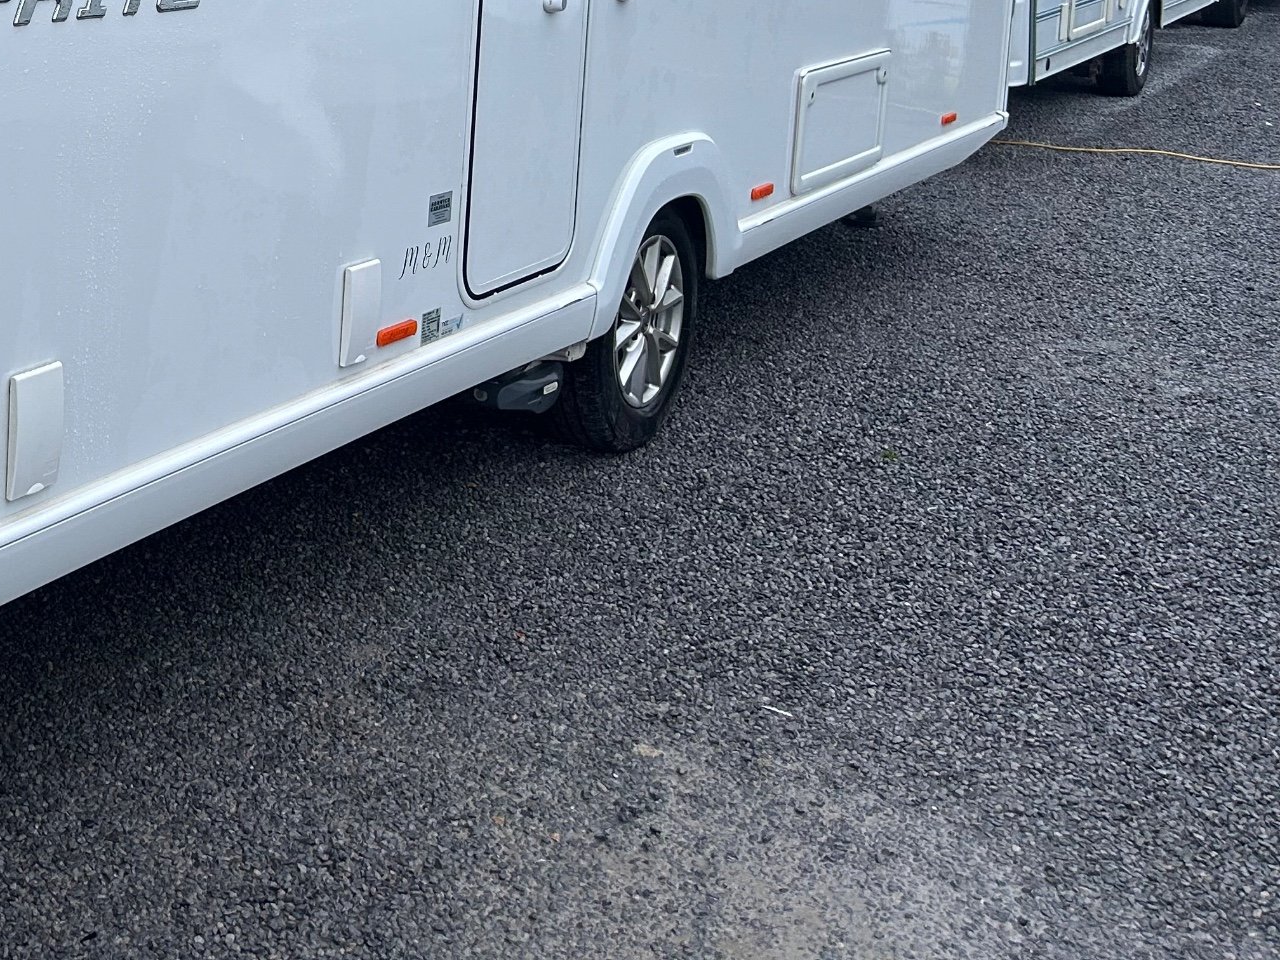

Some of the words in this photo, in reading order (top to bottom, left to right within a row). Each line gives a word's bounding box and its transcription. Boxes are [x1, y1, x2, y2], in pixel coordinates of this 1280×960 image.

[398, 245, 419, 280] M
[422, 242, 433, 269] &
[432, 235, 452, 269] M
